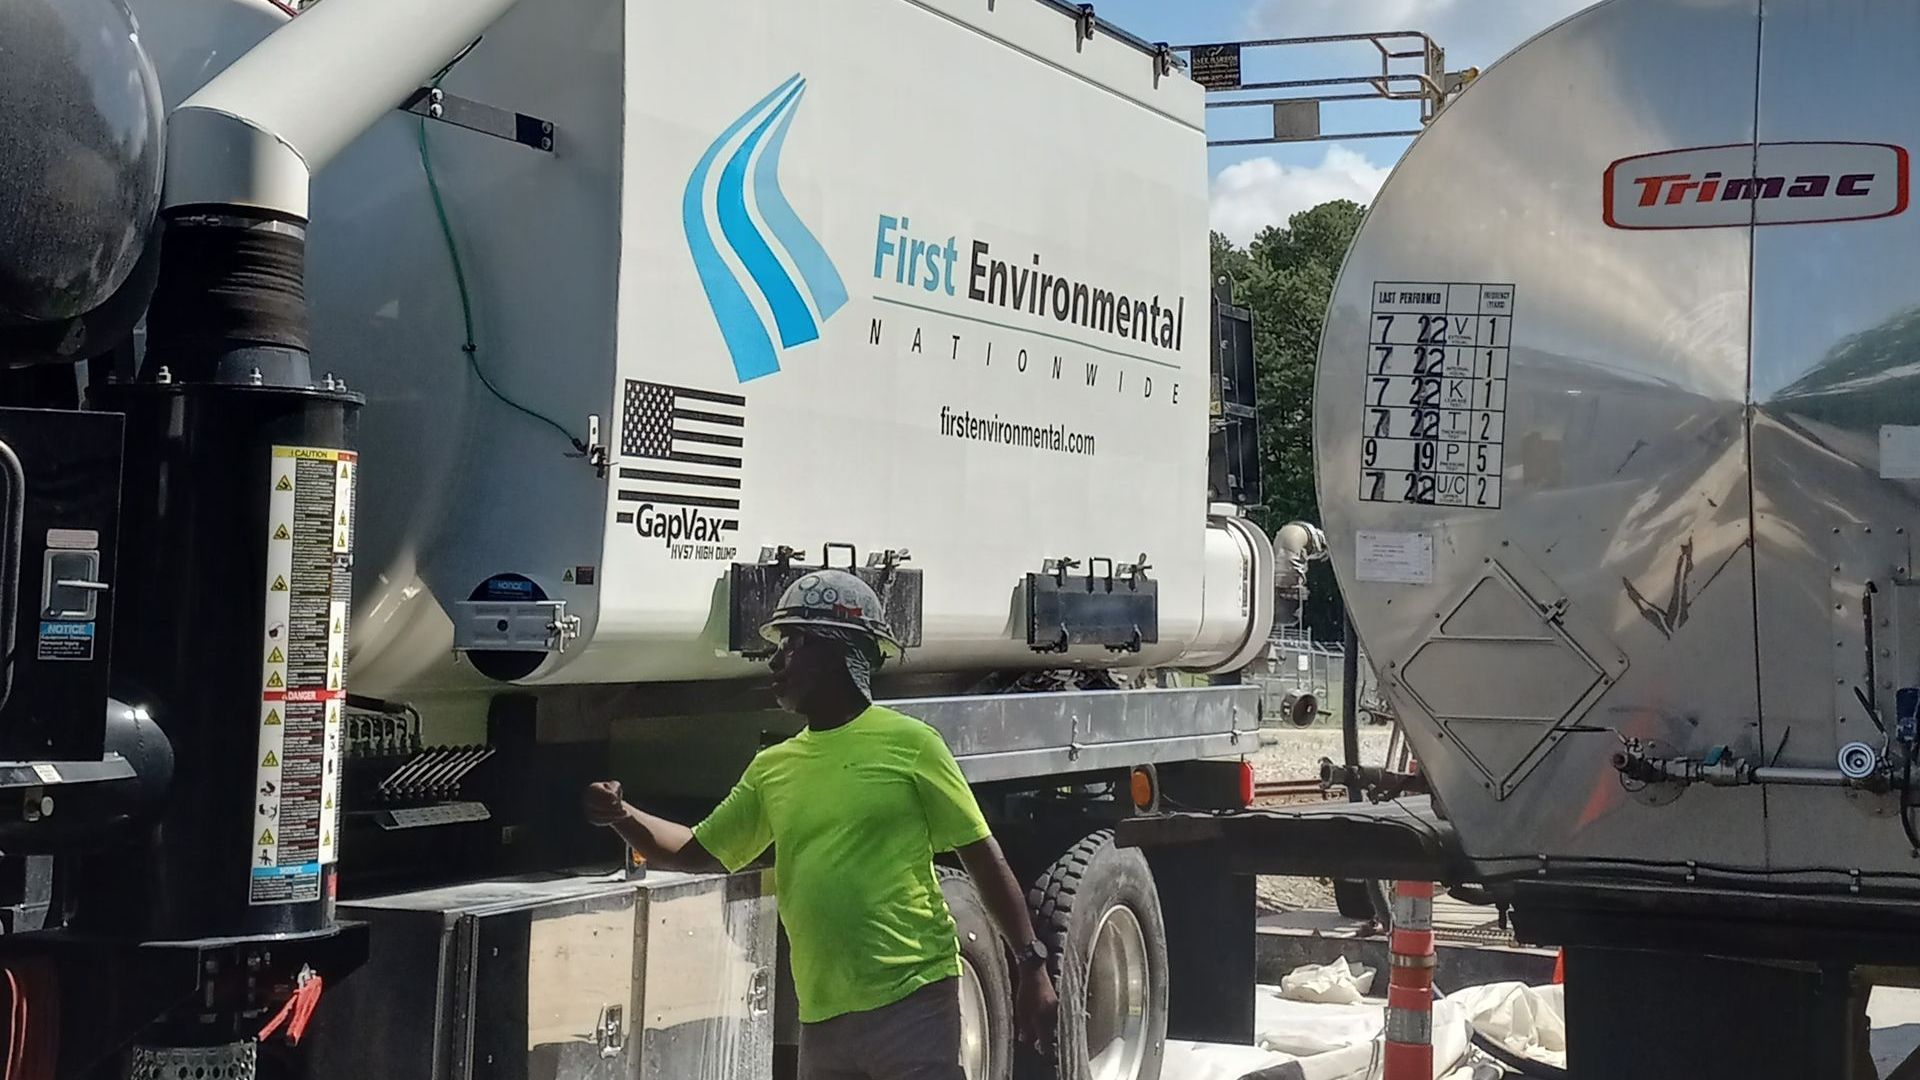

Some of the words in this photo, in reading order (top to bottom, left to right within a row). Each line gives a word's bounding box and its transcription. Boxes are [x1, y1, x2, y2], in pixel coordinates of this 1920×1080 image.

[1633, 172, 1875, 207] Trimac
[873, 214, 958, 296] First
[968, 240, 1184, 351] Environmental
[1379, 292, 1396, 304] LAST
[1399, 292, 1441, 304] PERFORMED
[1377, 315, 1394, 344] 7
[1417, 315, 1448, 344] 22
[1455, 317, 1468, 335] V
[1489, 317, 1496, 345] 1
[870, 318, 1179, 404] NATIONWIDE
[1375, 346, 1393, 375] 7
[1413, 346, 1445, 375] 22
[1486, 350, 1493, 378] 1
[1373, 378, 1390, 406] 7
[1409, 377, 1440, 407] 22
[1450, 380, 1463, 398] K
[1485, 379, 1492, 408] 1
[940, 406, 1095, 456] firstenvironmental.com
[1371, 408, 1389, 437] 7
[1410, 408, 1440, 438] 22
[1448, 411, 1462, 430] T
[1480, 412, 1490, 440] 2
[1365, 439, 1377, 466] 9
[1414, 441, 1434, 472] 19
[1446, 444, 1459, 461] P
[1477, 445, 1487, 472] 5
[1366, 472, 1384, 500] 7
[1404, 473, 1435, 504] 22
[1437, 475, 1465, 494] U/C
[1477, 477, 1486, 505] 2
[636, 503, 722, 549] GapVax
[670, 544, 694, 559] HV57
[695, 545, 714, 560] HIGH
[715, 546, 737, 560] DUMP
[47, 624, 87, 635] NOTICE
